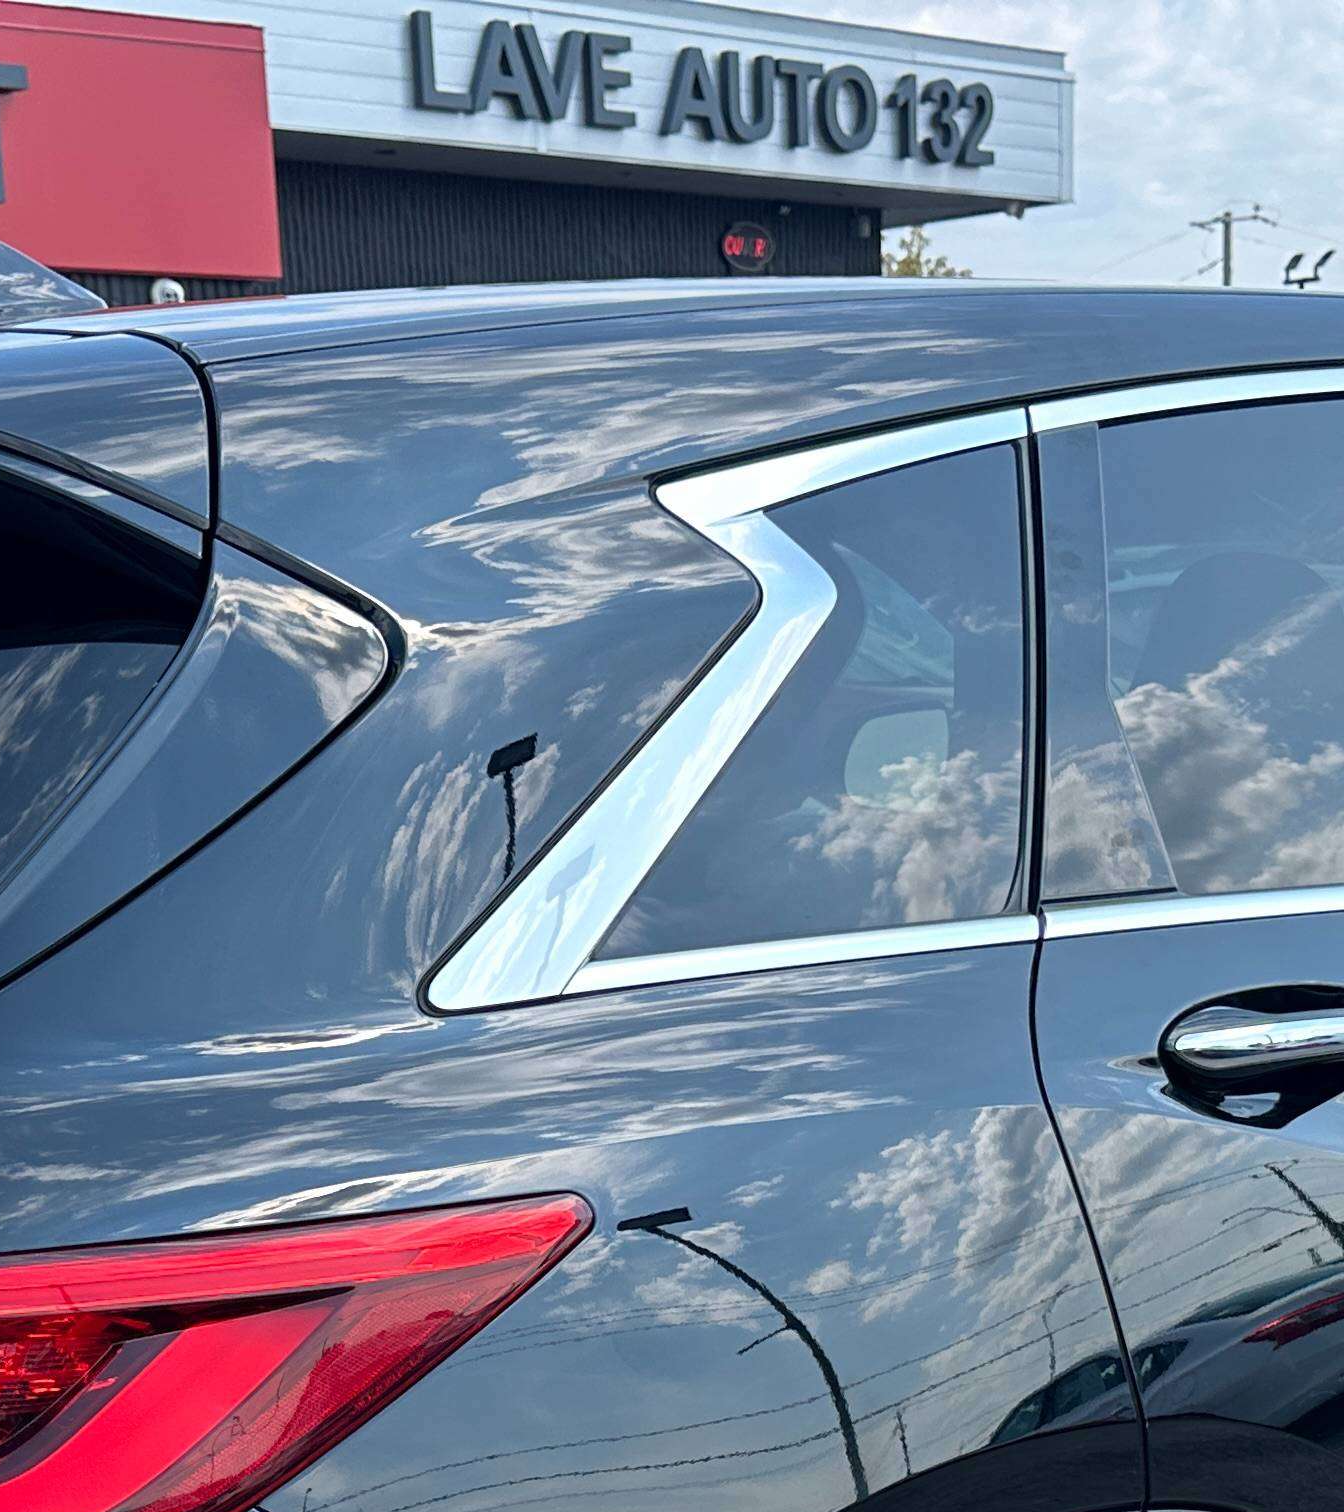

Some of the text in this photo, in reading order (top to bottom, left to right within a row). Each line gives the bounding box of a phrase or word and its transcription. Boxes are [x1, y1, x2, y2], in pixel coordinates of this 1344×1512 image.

[409, 9, 995, 167] LAVE AUTO 132
